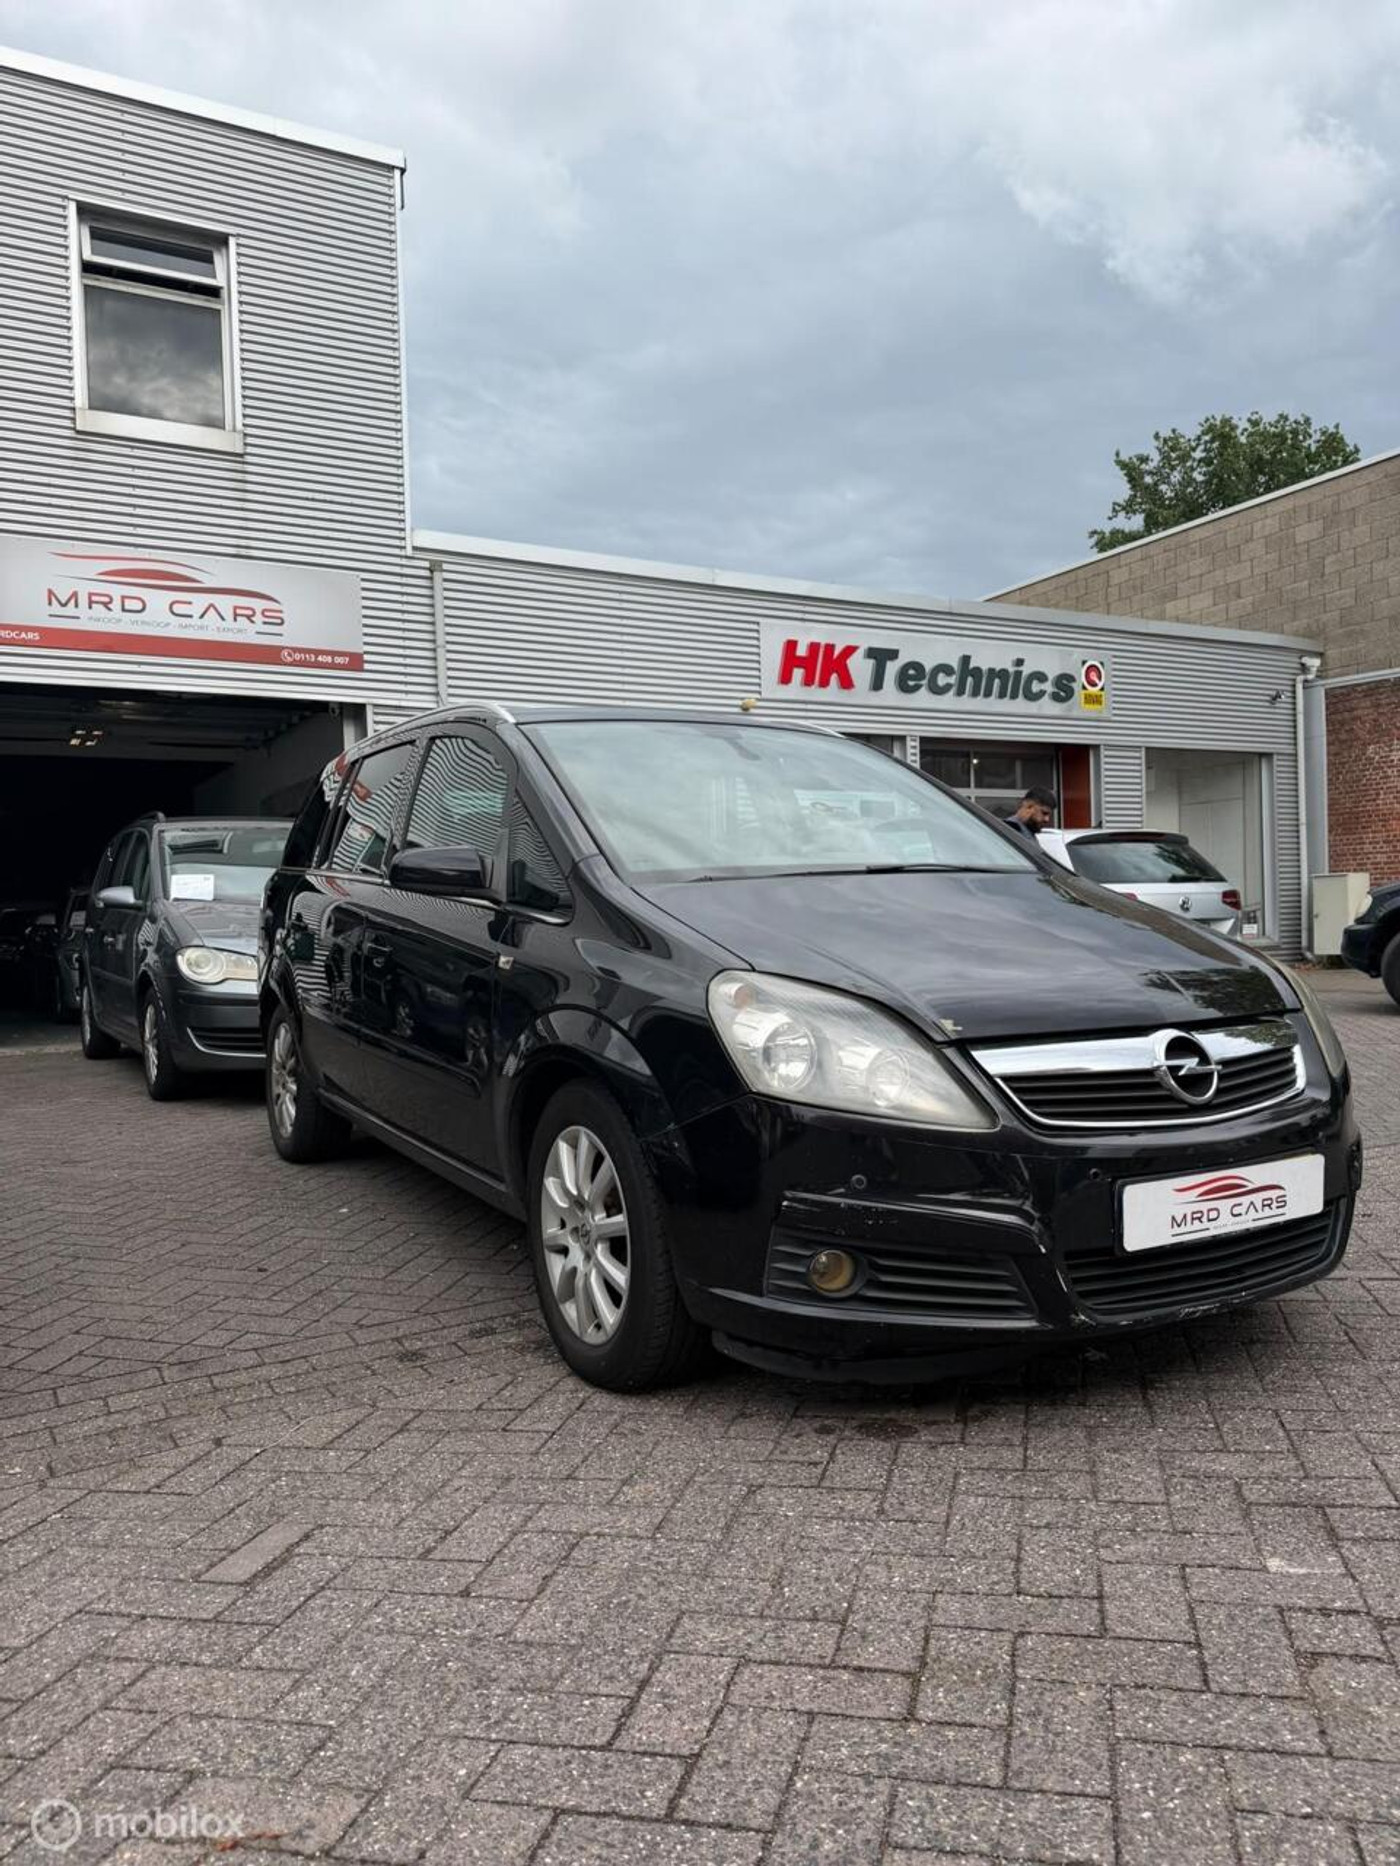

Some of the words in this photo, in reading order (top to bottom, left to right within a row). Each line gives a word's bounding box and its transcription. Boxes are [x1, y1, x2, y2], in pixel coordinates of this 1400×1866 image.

[47, 588, 147, 615] MRD
[168, 599, 285, 627] CARS
[294, 652, 315, 662] 0113
[334, 656, 350, 665] 007
[777, 638, 859, 691] HK
[864, 646, 1077, 704] Technics
[1171, 1207, 1220, 1230] MRD
[1230, 1194, 1288, 1218] CARS
